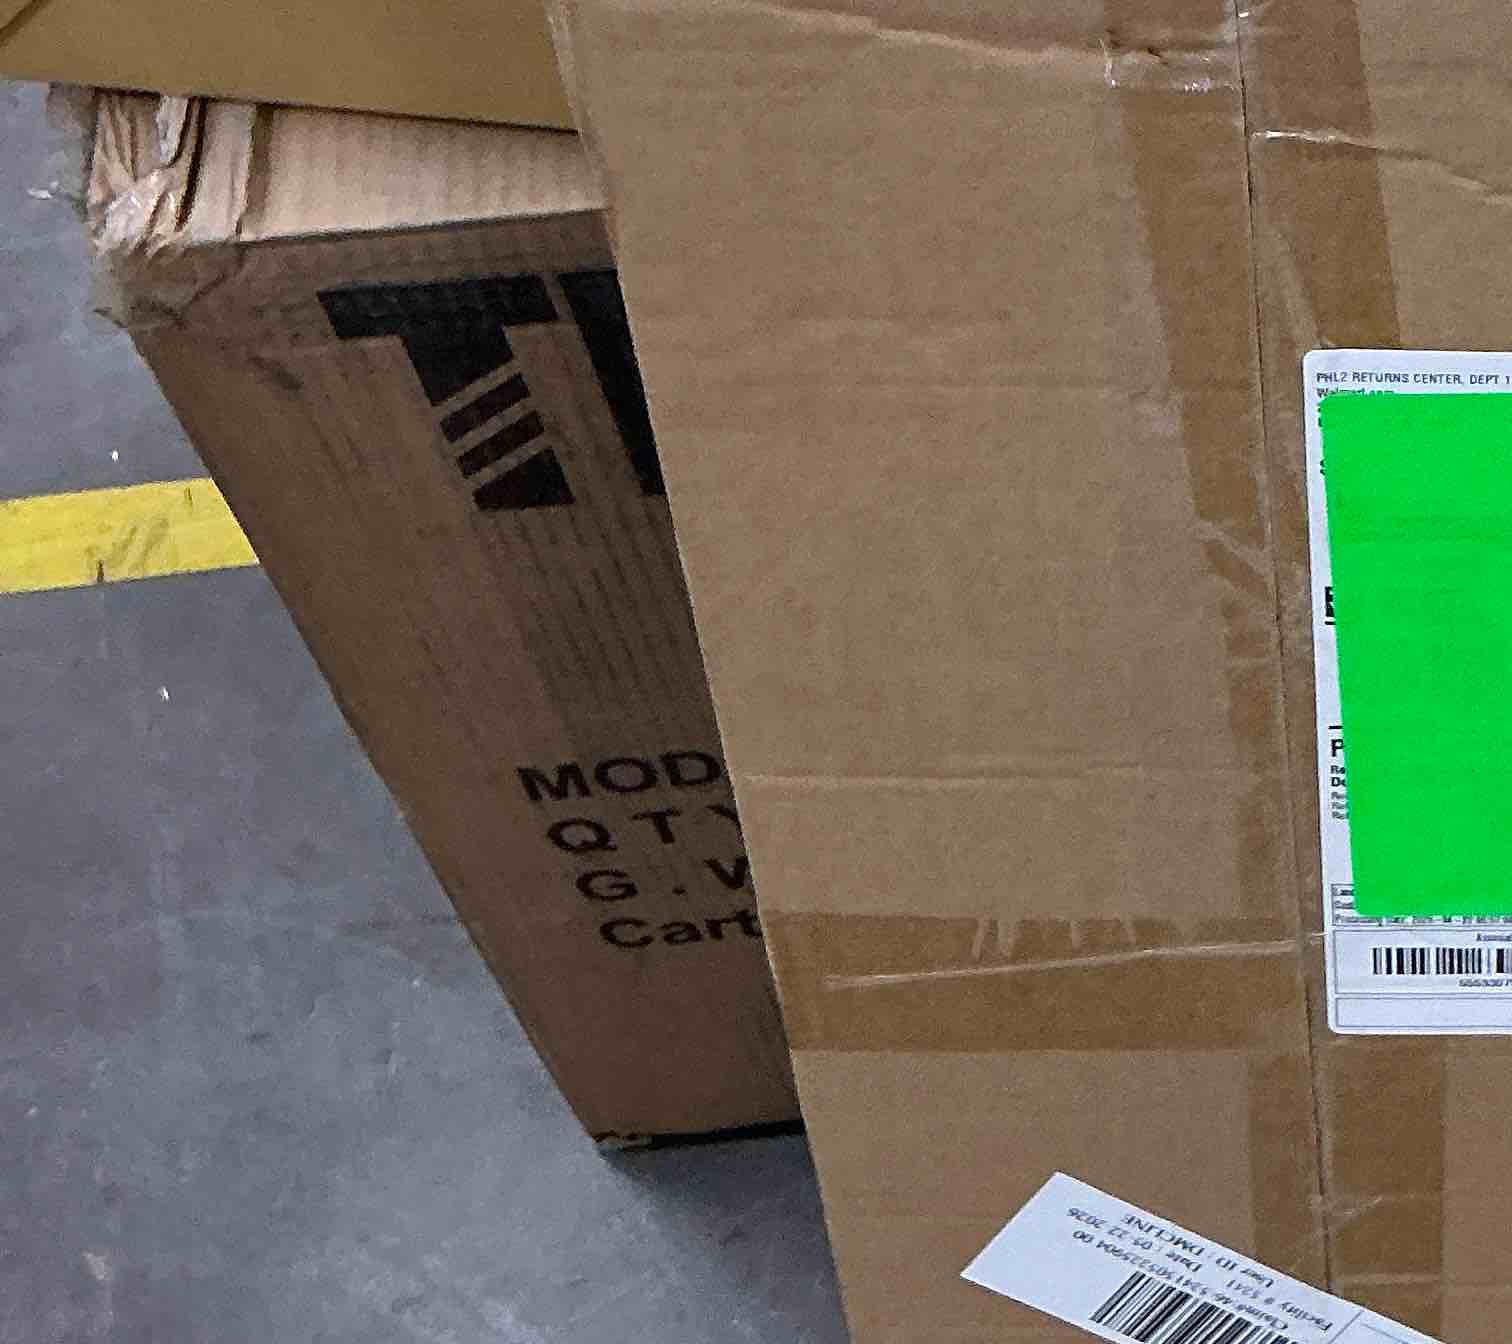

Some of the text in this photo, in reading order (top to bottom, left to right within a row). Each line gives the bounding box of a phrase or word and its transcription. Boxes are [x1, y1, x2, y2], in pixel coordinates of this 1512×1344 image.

[1352, 372, 1410, 384] RETURNS
[1469, 374, 1500, 385] DEPT
[1280, 1301, 1333, 1331] Facility
